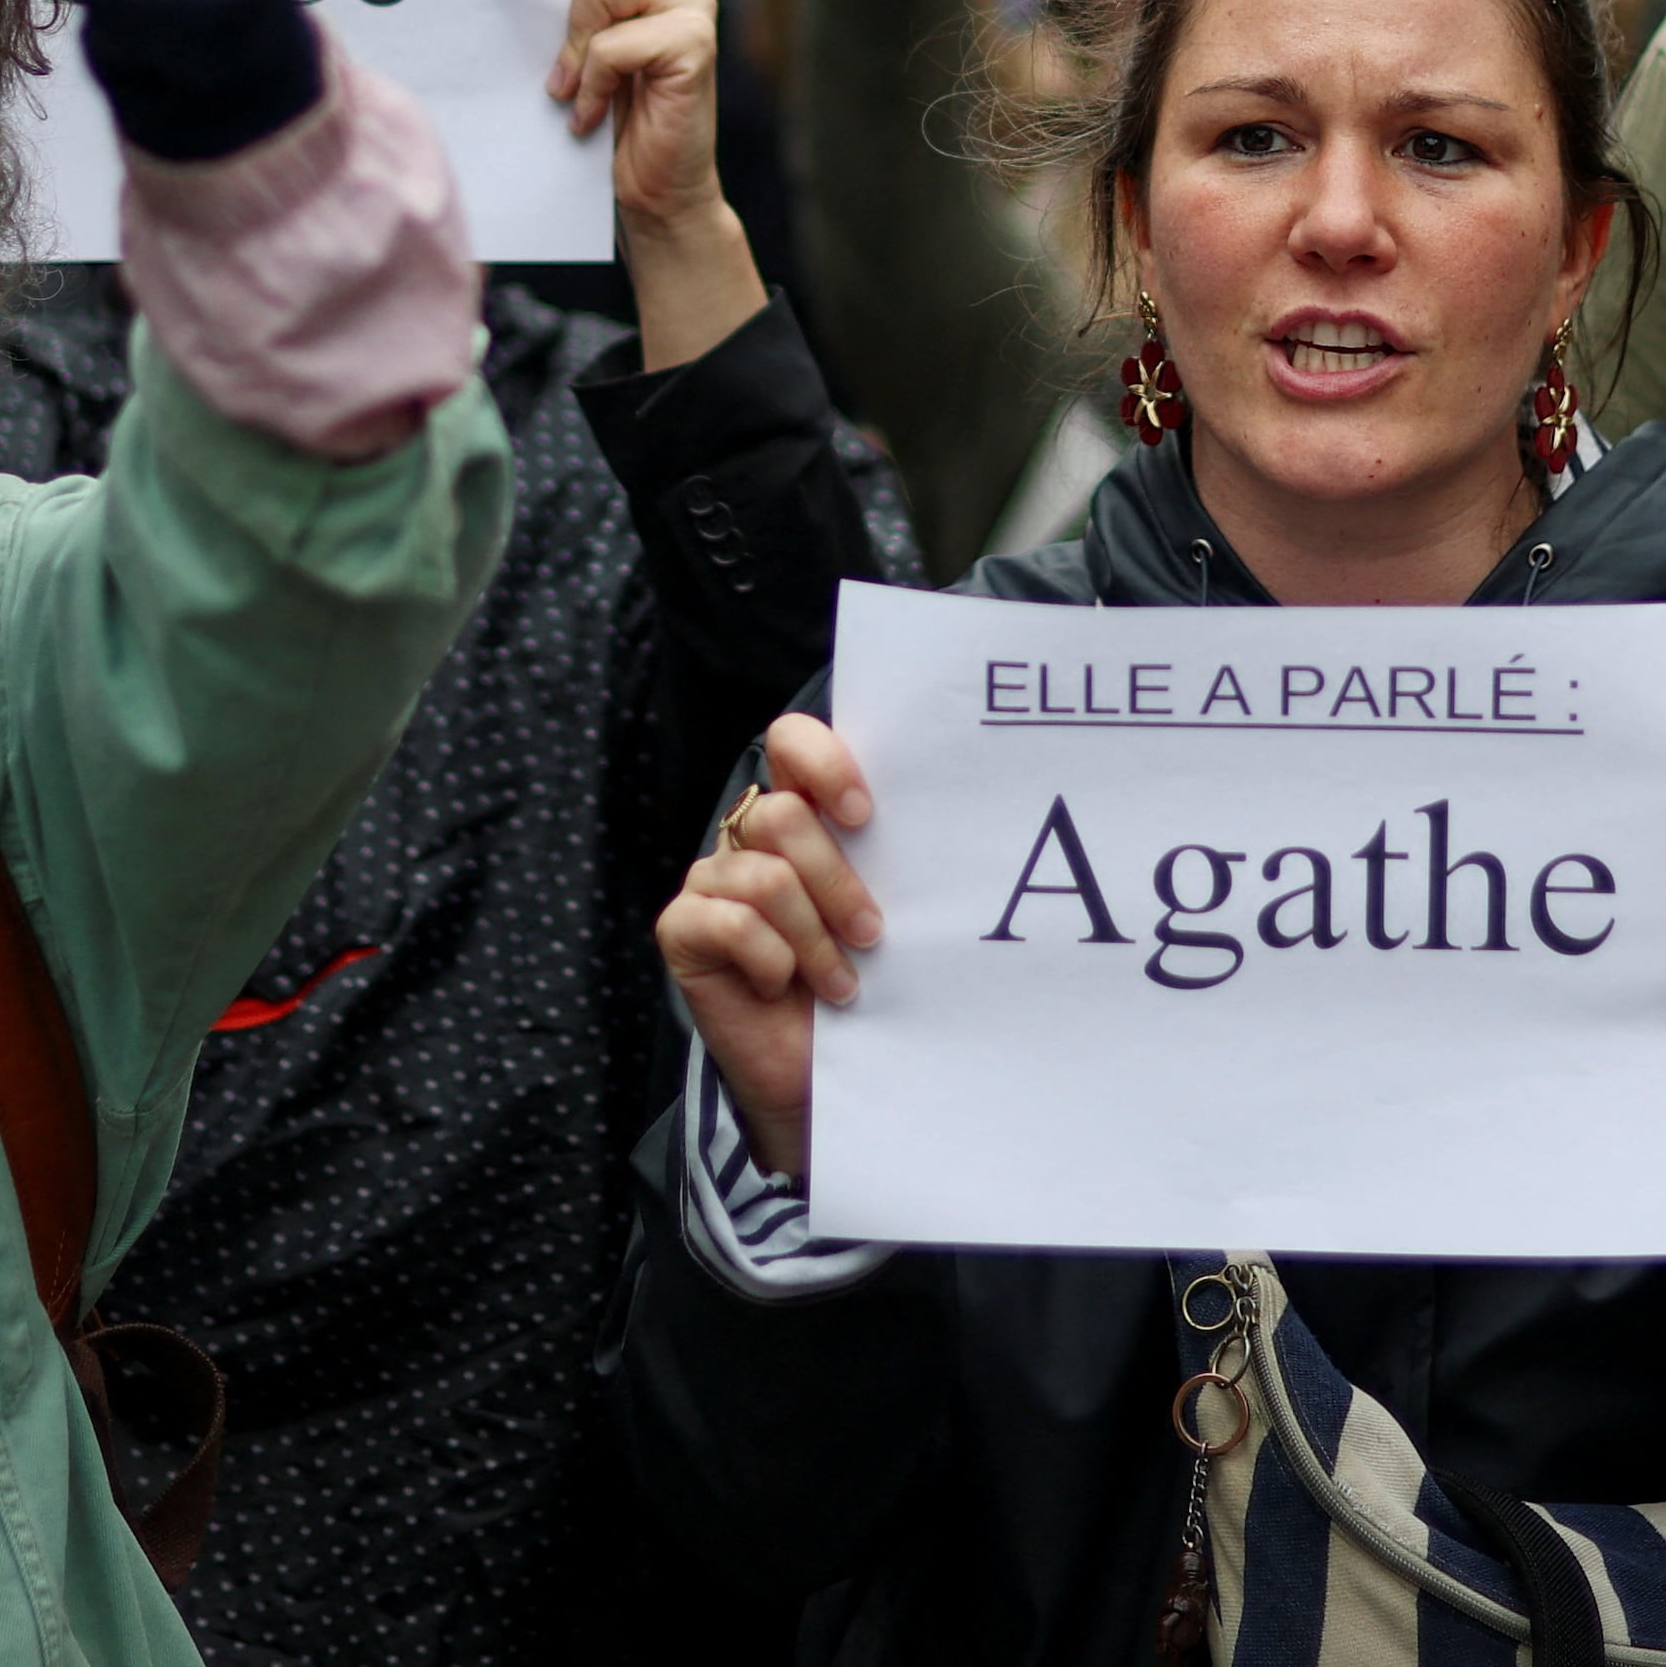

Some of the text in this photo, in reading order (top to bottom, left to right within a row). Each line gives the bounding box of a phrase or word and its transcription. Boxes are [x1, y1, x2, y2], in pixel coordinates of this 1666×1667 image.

[986, 660, 1173, 715] ELLE
[1199, 664, 1252, 716] A
[1281, 653, 1537, 722] PARLÉ
[979, 793, 1617, 990] Agathe
